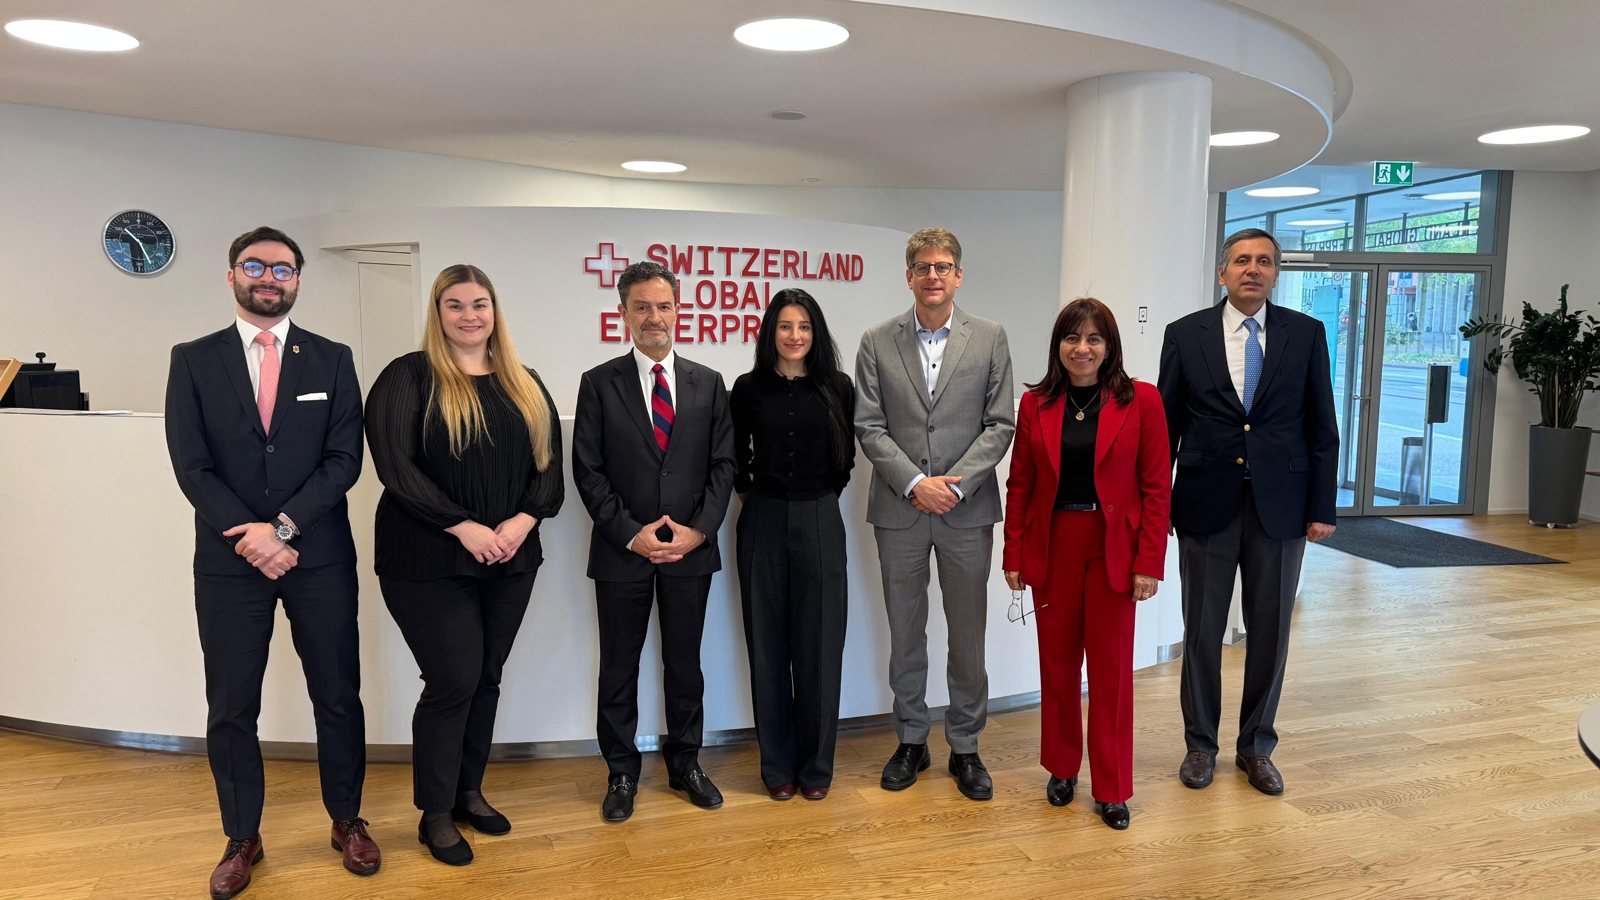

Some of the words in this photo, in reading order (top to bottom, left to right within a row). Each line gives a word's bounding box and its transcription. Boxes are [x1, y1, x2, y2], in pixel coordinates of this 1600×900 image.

[647, 243, 864, 282] SWITZERLAND
[675, 279, 770, 310] LOBAL
[600, 311, 762, 343] EERPR
